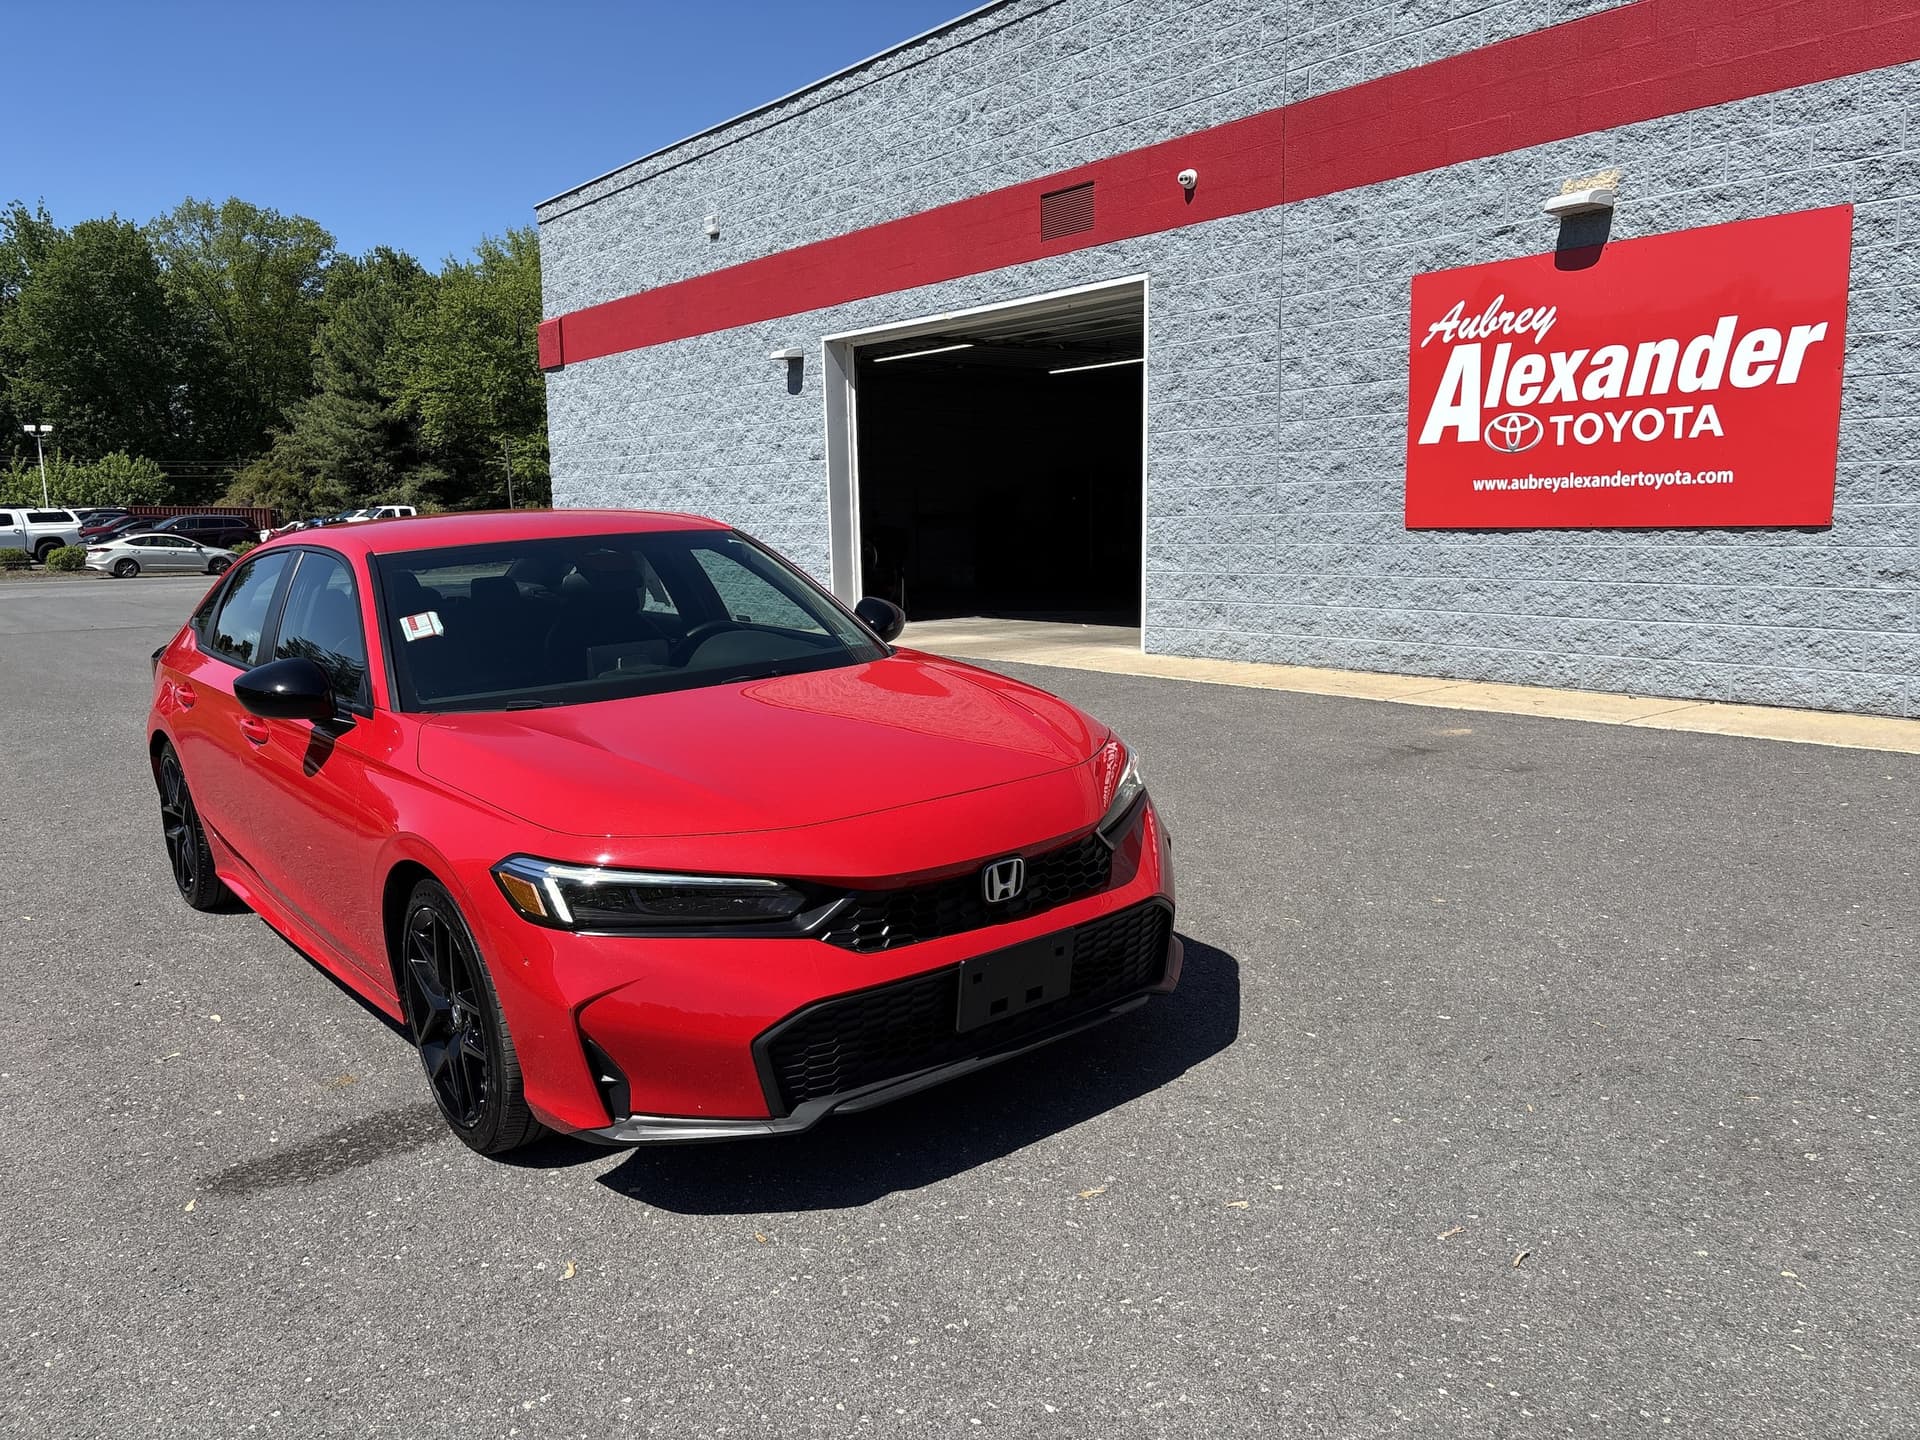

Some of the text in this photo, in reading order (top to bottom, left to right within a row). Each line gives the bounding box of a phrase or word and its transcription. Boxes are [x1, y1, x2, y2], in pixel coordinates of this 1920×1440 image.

[1420, 293, 1558, 348] Aubrey
[1417, 314, 1829, 445] Alexander
[1548, 404, 1725, 447] TOYOTA
[1472, 468, 1735, 493] www.aubreyalexandertoyota.com
